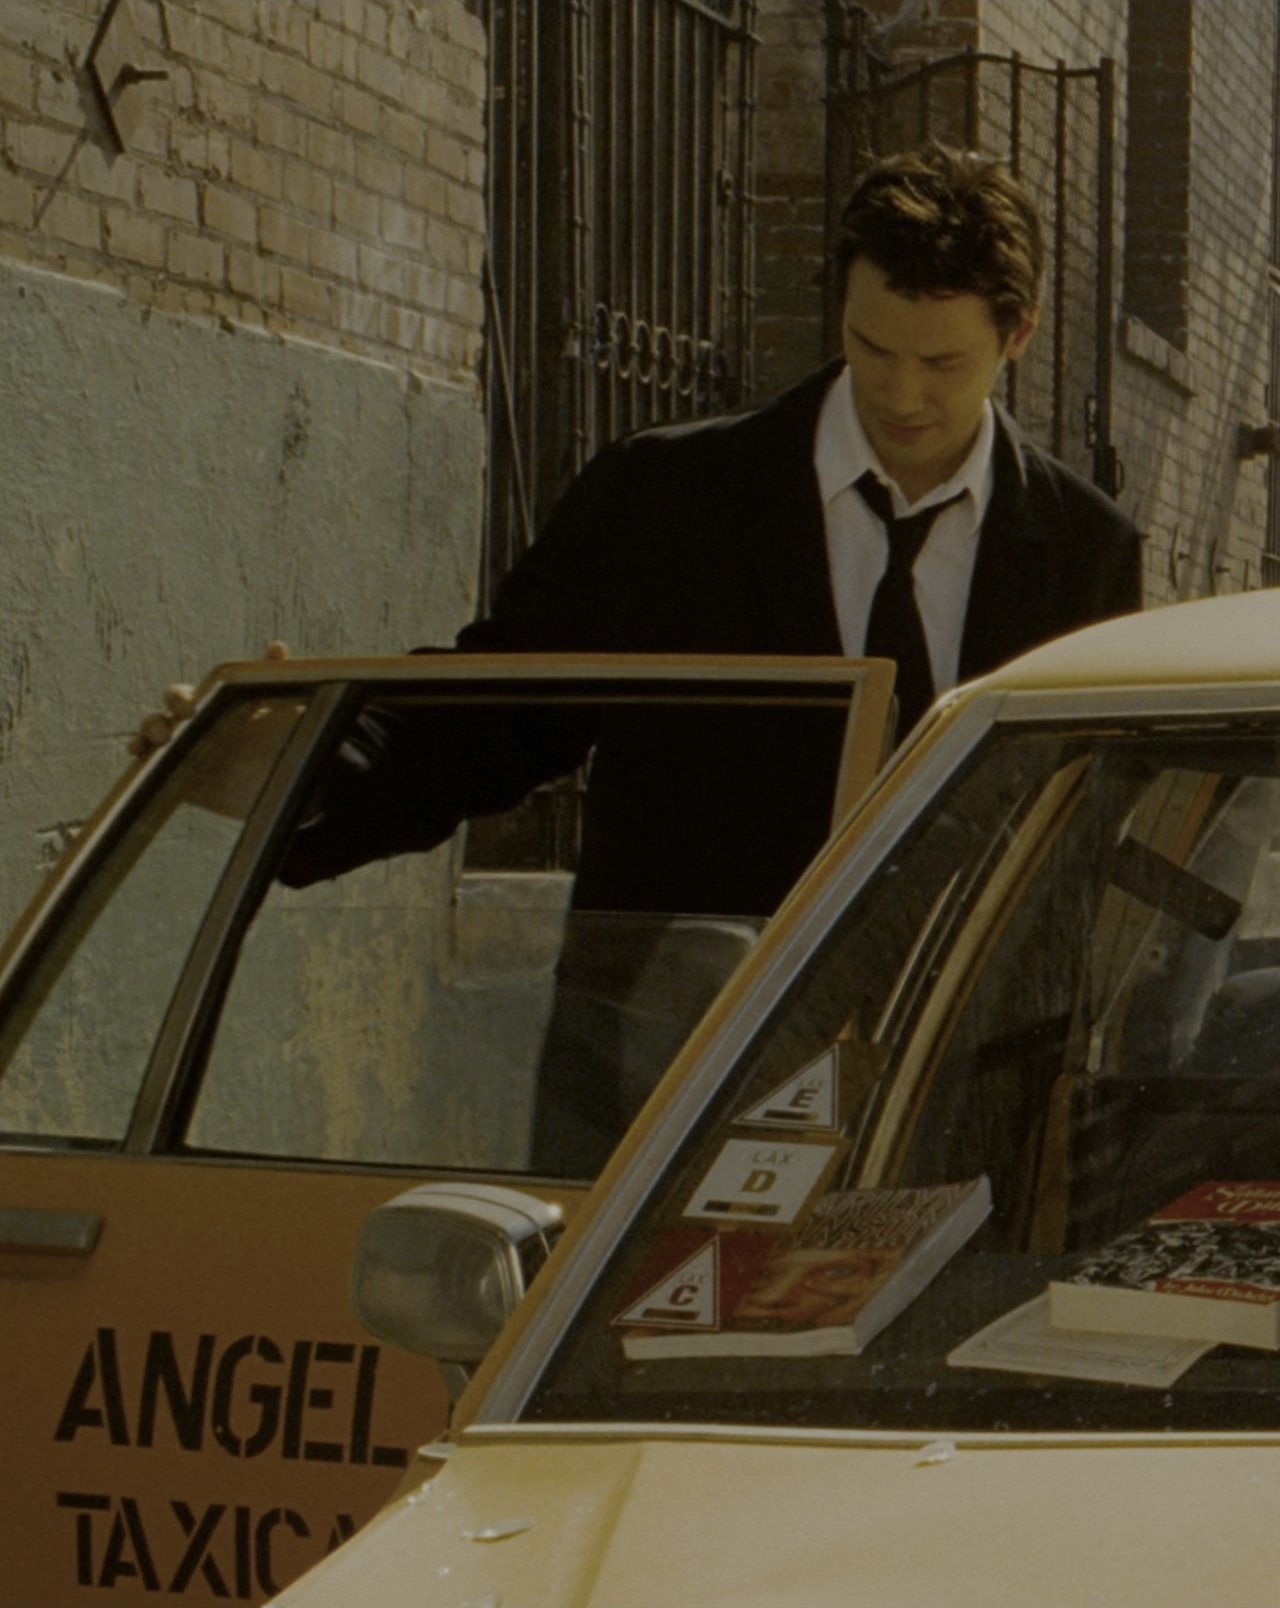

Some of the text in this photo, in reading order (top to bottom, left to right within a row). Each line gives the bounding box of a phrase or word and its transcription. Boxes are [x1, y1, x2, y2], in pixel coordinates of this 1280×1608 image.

[788, 1088, 819, 1109] E
[752, 1150, 793, 1165] LAX
[740, 1169, 777, 1193] D
[668, 1283, 699, 1307] C
[54, 1328, 408, 1467] ANGEL
